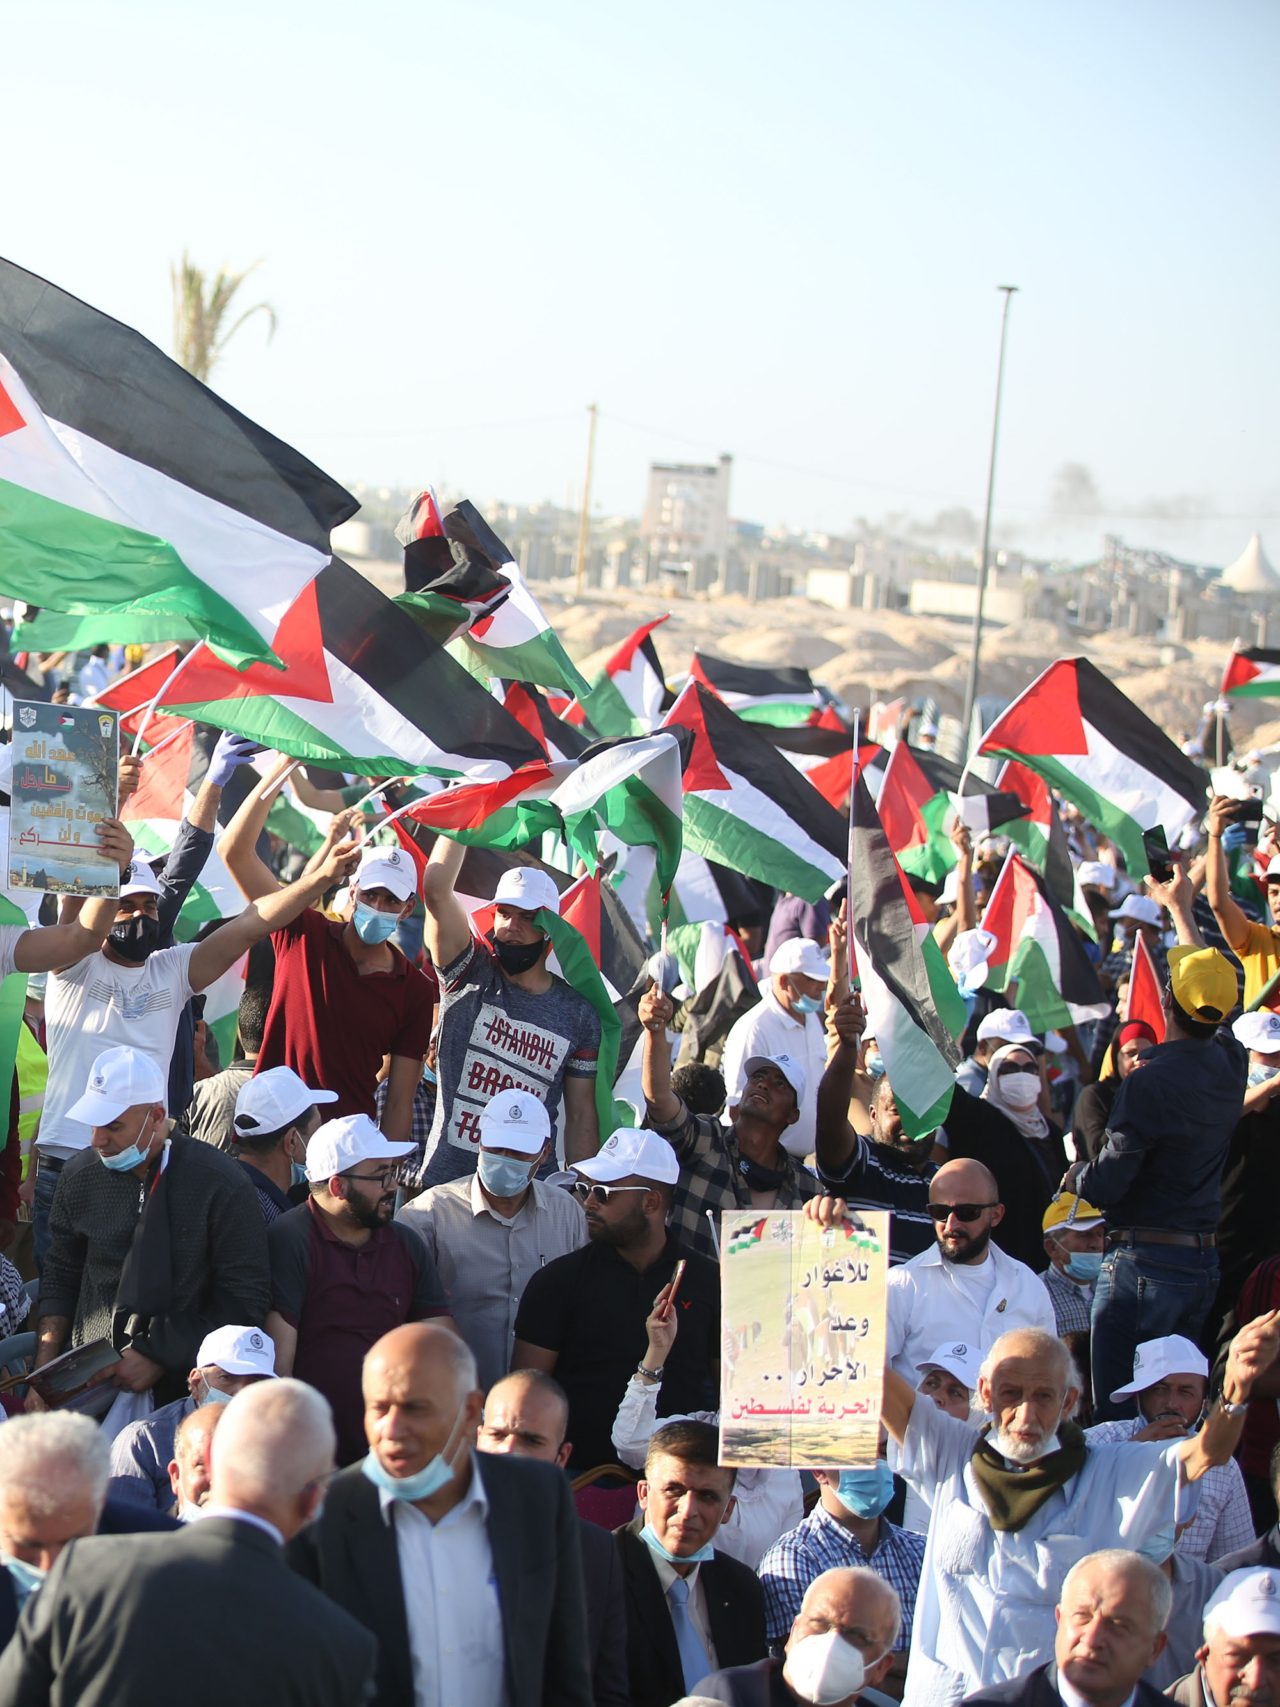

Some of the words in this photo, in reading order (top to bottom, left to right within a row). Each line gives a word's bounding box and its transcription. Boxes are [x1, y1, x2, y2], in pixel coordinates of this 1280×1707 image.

[25, 738, 46, 760] الله
[45, 765, 57, 784] ما
[830, 1312, 869, 1337] وعد
[732, 1395, 812, 1419] لفلسطين
[817, 1395, 876, 1419] الحرية
